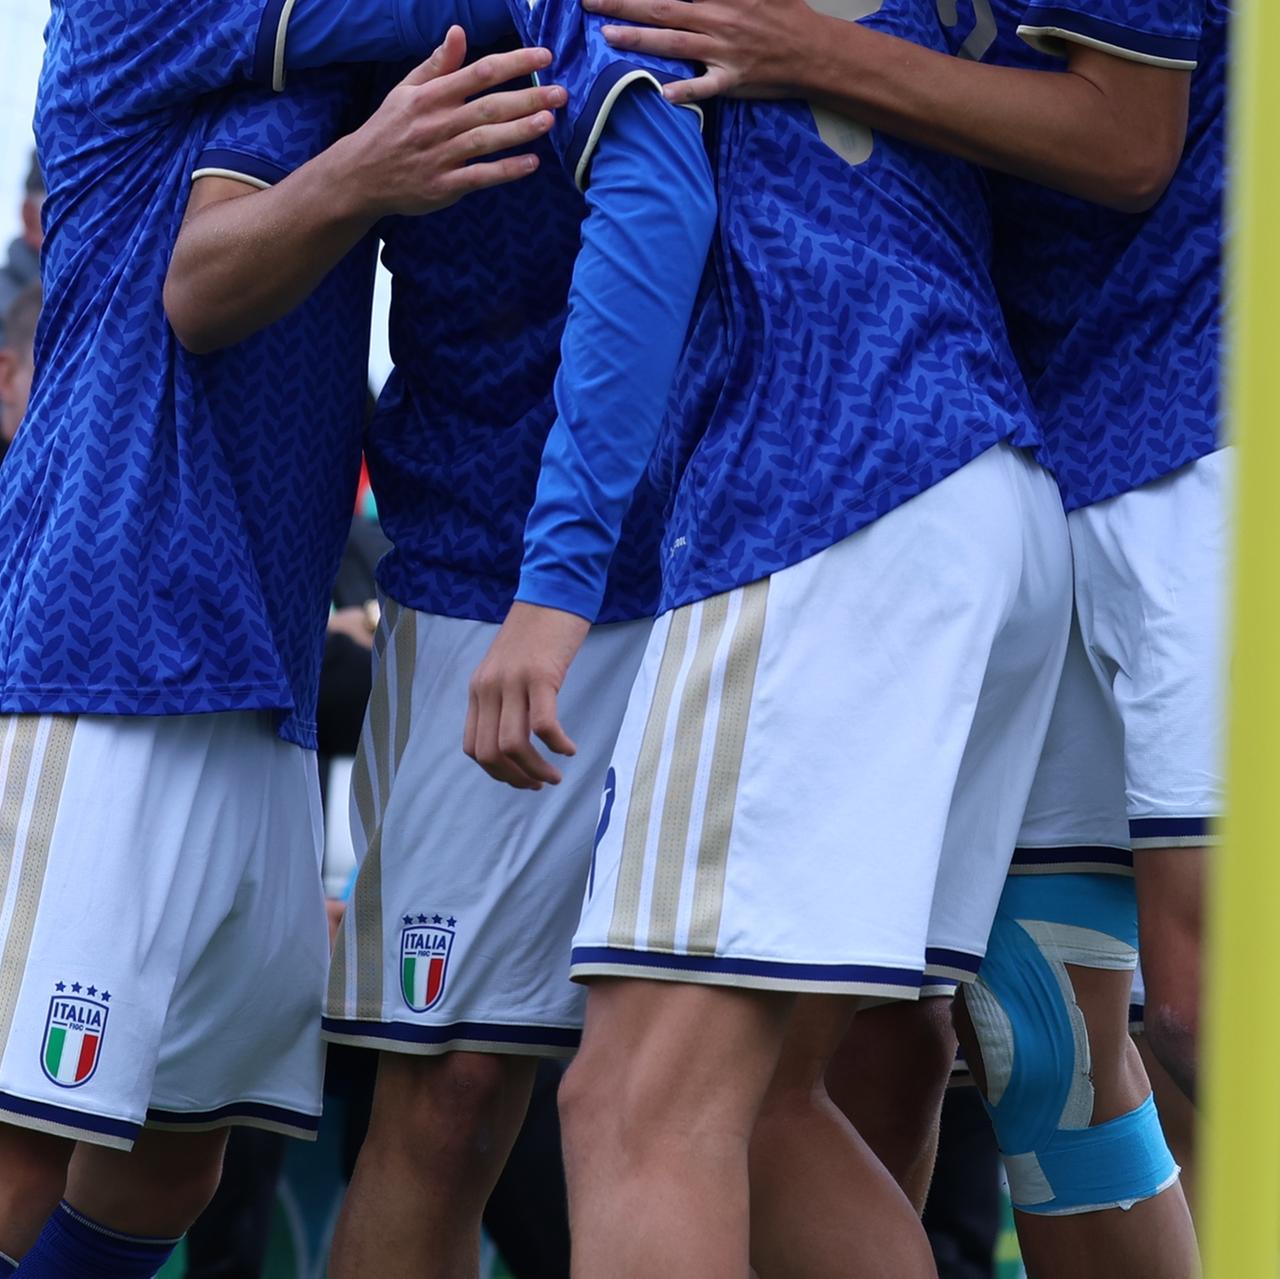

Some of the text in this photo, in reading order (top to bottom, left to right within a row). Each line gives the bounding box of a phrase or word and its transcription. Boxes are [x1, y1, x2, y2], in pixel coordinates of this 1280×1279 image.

[405, 933, 447, 951] ITALIA
[53, 1002, 102, 1027] ITALIA
[69, 1022, 84, 1031] FIGC
